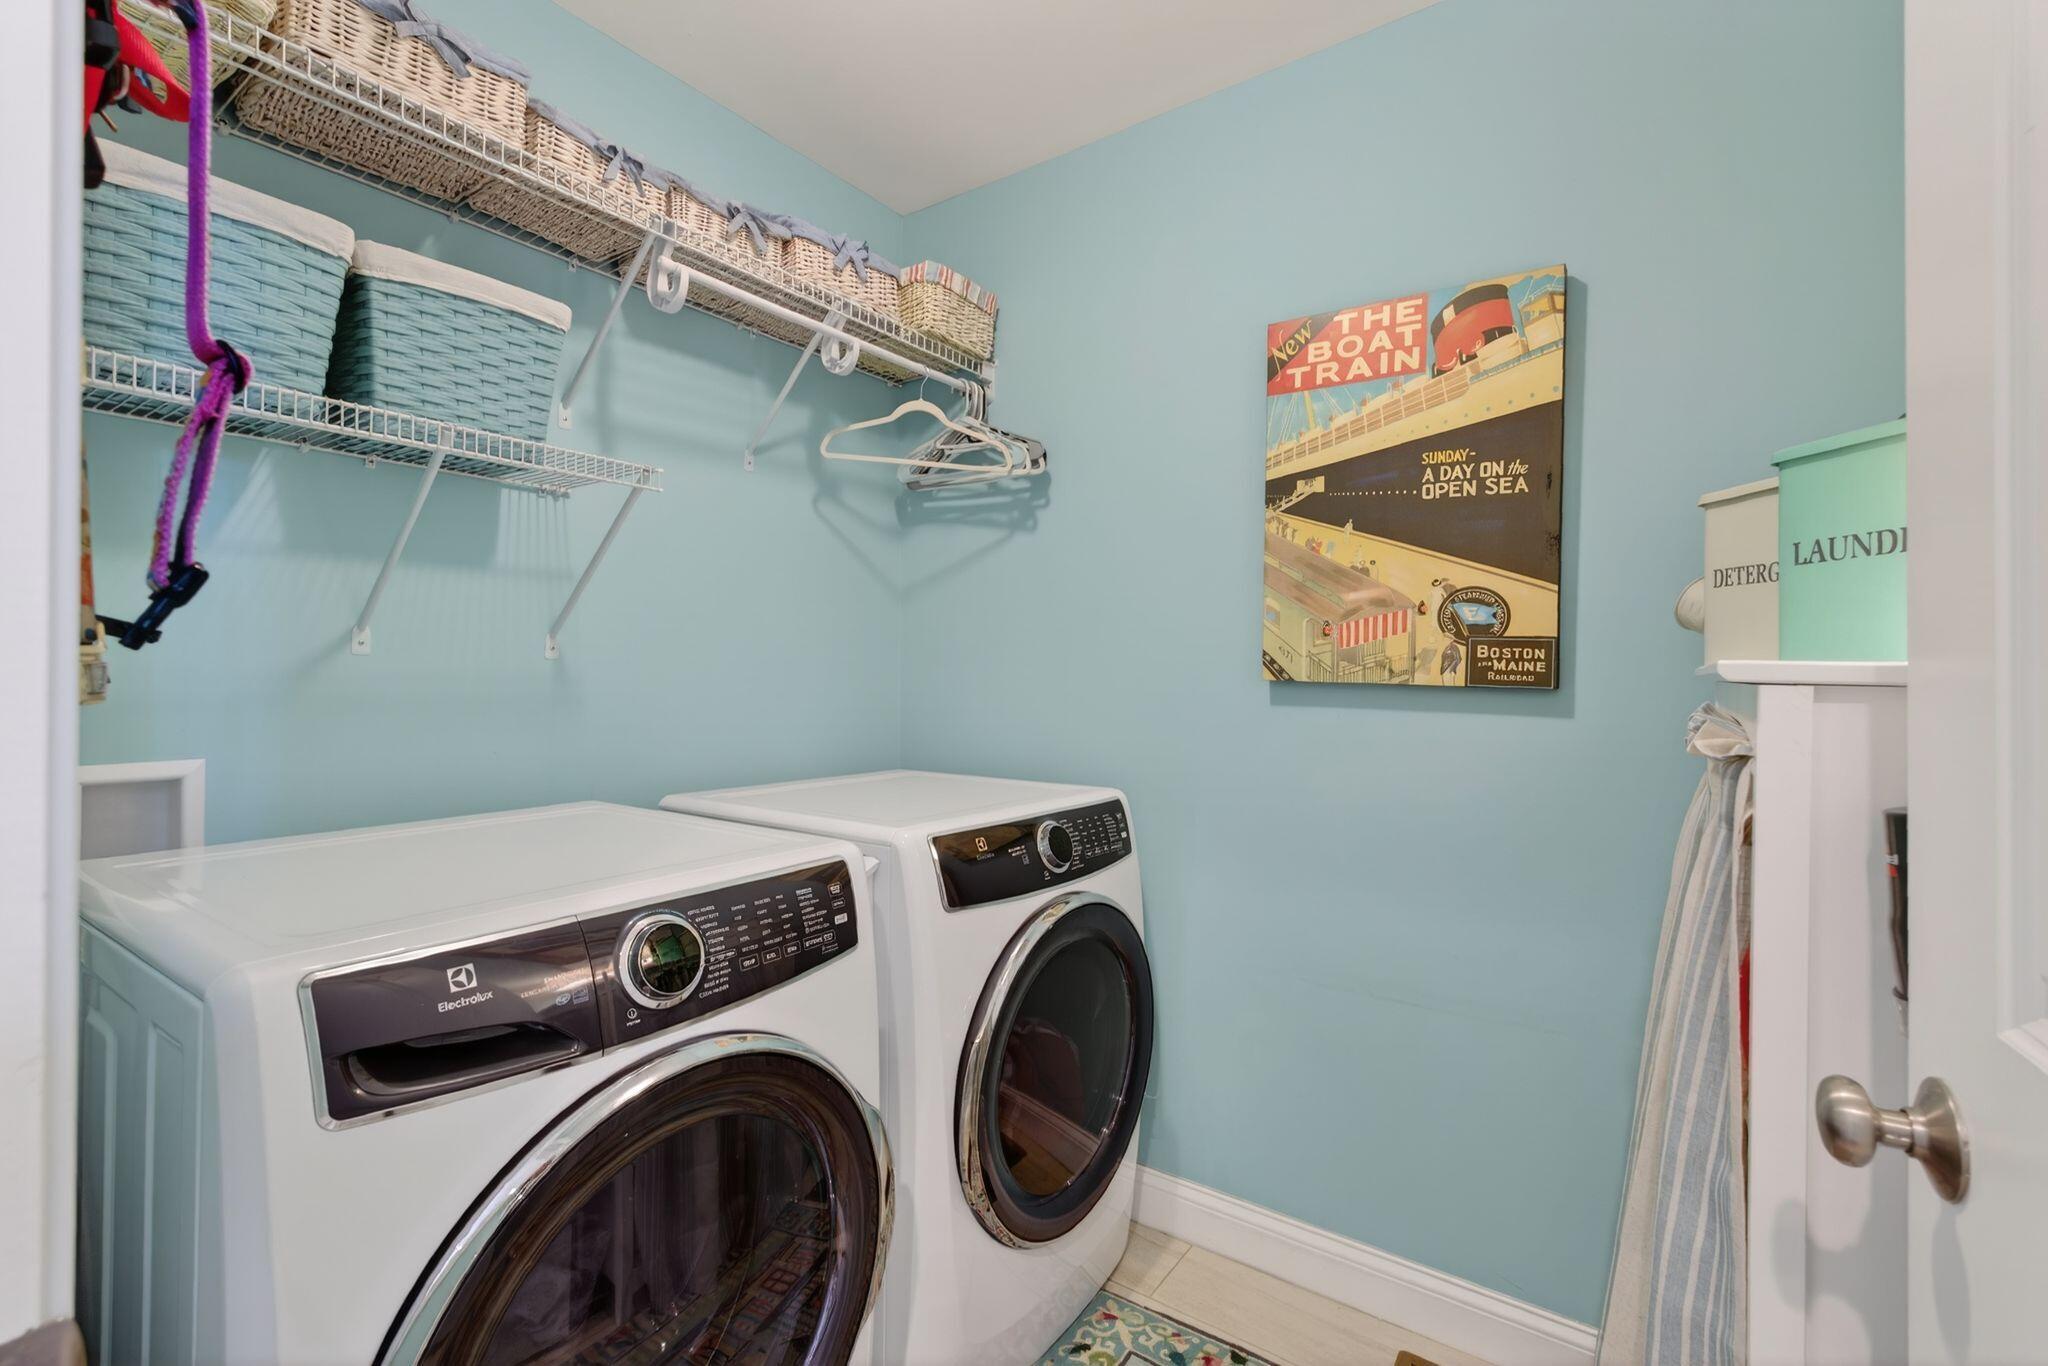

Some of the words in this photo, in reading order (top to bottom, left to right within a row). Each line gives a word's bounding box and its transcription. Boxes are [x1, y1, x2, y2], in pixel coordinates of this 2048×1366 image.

[1333, 298, 1423, 335] THE
[1271, 319, 1313, 382] New
[1307, 323, 1422, 364] BOAT
[1286, 349, 1421, 388] TRAIN
[1421, 467, 1435, 483] A
[1440, 463, 1475, 481] DAY
[1479, 460, 1504, 478] ON
[1506, 459, 1529, 476] the
[1421, 480, 1477, 500] OPEN
[1485, 476, 1529, 495] SEA
[1477, 645, 1545, 660] BOSTON
[1493, 659, 1546, 672] MAINE
[437, 991, 493, 1013] Electrolux
